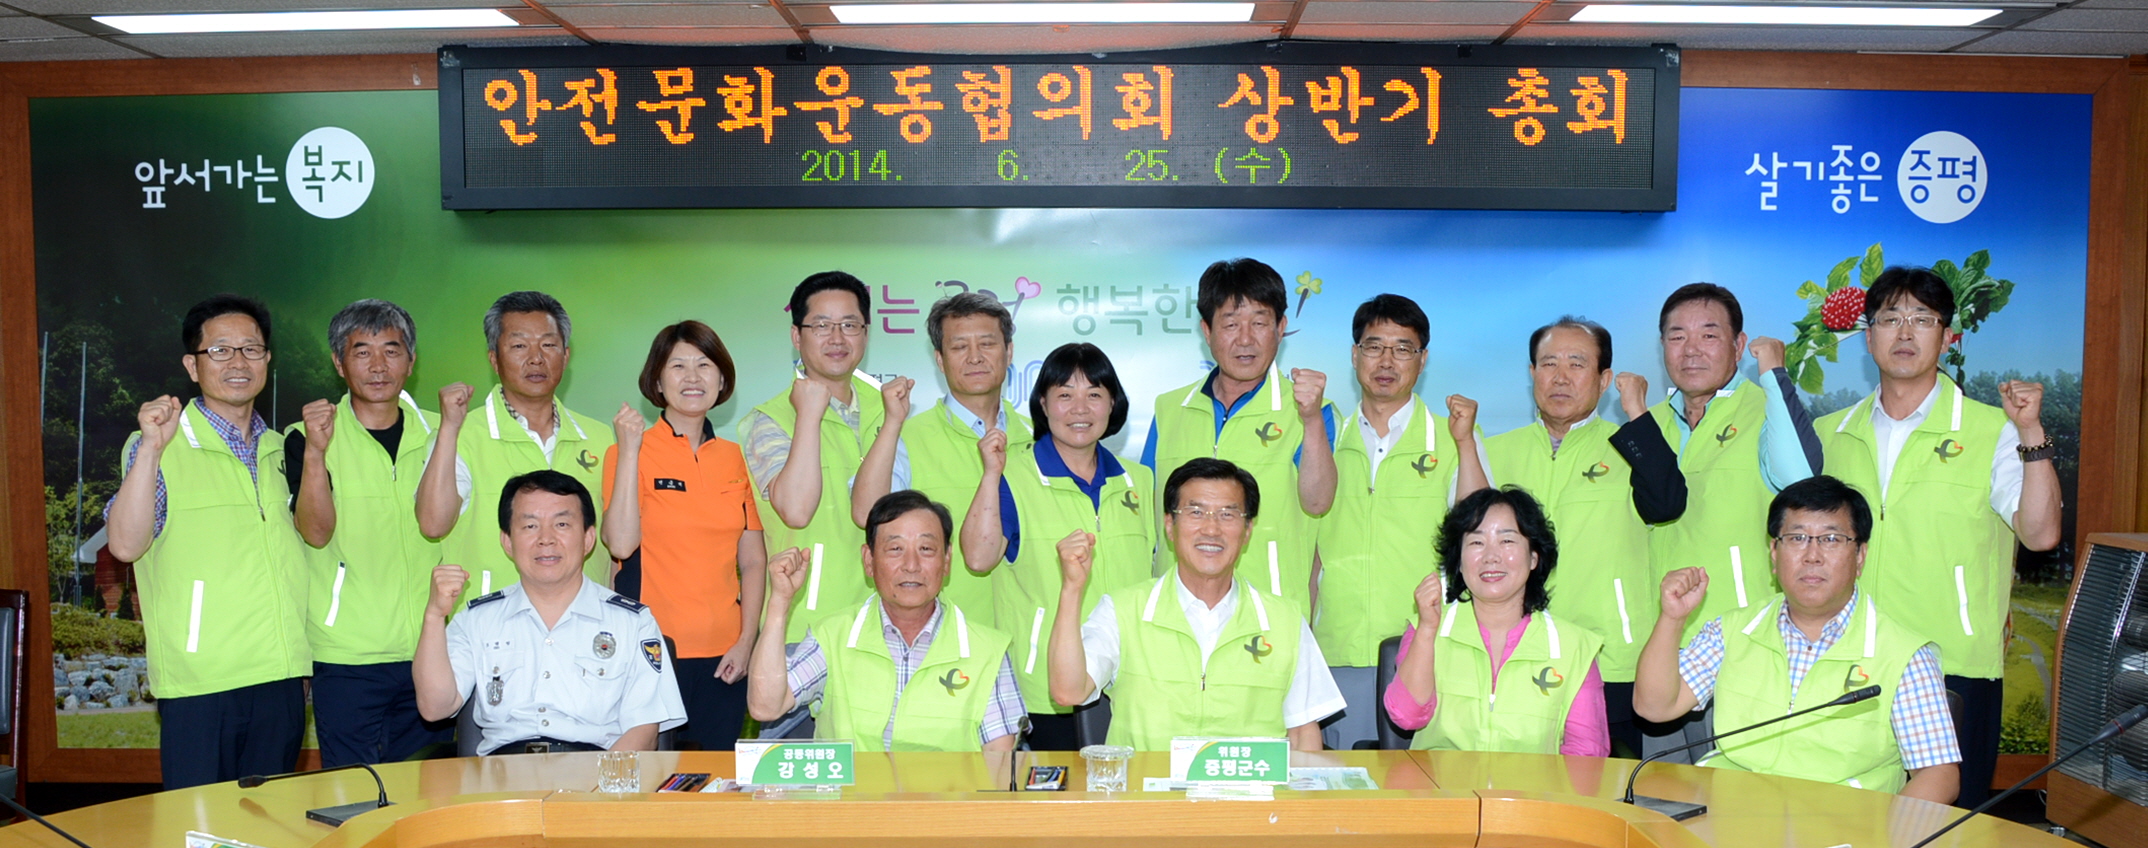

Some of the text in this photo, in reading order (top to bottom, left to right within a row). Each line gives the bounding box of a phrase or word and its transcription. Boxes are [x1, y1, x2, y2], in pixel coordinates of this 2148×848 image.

[484, 64, 1629, 146] 안전문화운동협의회 상반기 총회
[134, 145, 363, 209] 앞서가는 복지
[801, 147, 1291, 184] 2014. 6. 25. (수)
[1745, 145, 1977, 214] 살기좋은 증평
[1056, 283, 1199, 336] 행복한
[783, 748, 836, 760] 공동위원장
[1204, 759, 1271, 777] 증평군수
[1218, 746, 1252, 758] 위원장
